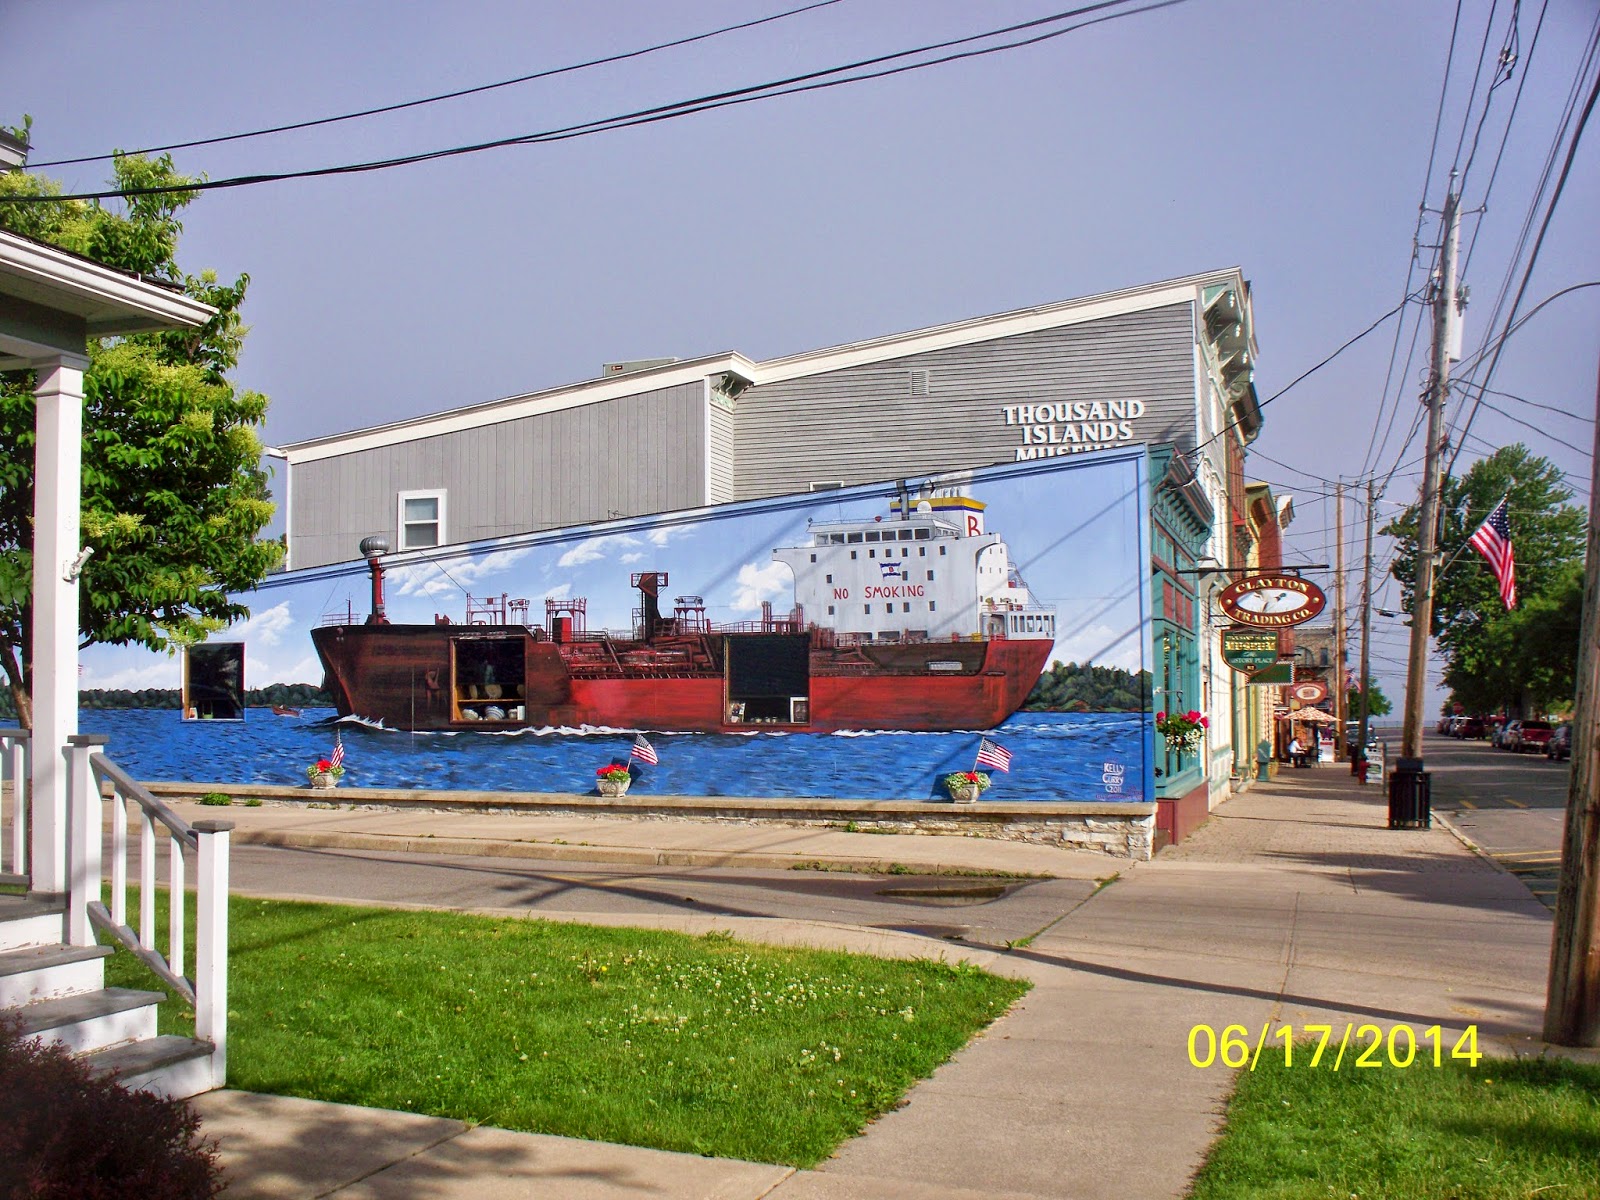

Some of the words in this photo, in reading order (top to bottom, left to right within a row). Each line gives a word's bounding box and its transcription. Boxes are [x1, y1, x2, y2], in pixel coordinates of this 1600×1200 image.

[1003, 400, 1145, 425] THOUSAND
[1022, 421, 1133, 445] ISLANDS
[834, 588, 849, 599] NO
[865, 585, 924, 598] SMOKING
[1235, 578, 1309, 593] CLAYTON
[1234, 608, 1291, 624] TRADING
[1292, 608, 1313, 621] CO.
[1225, 641, 1276, 650] MUSEUM
[1103, 763, 1124, 774] KELLY
